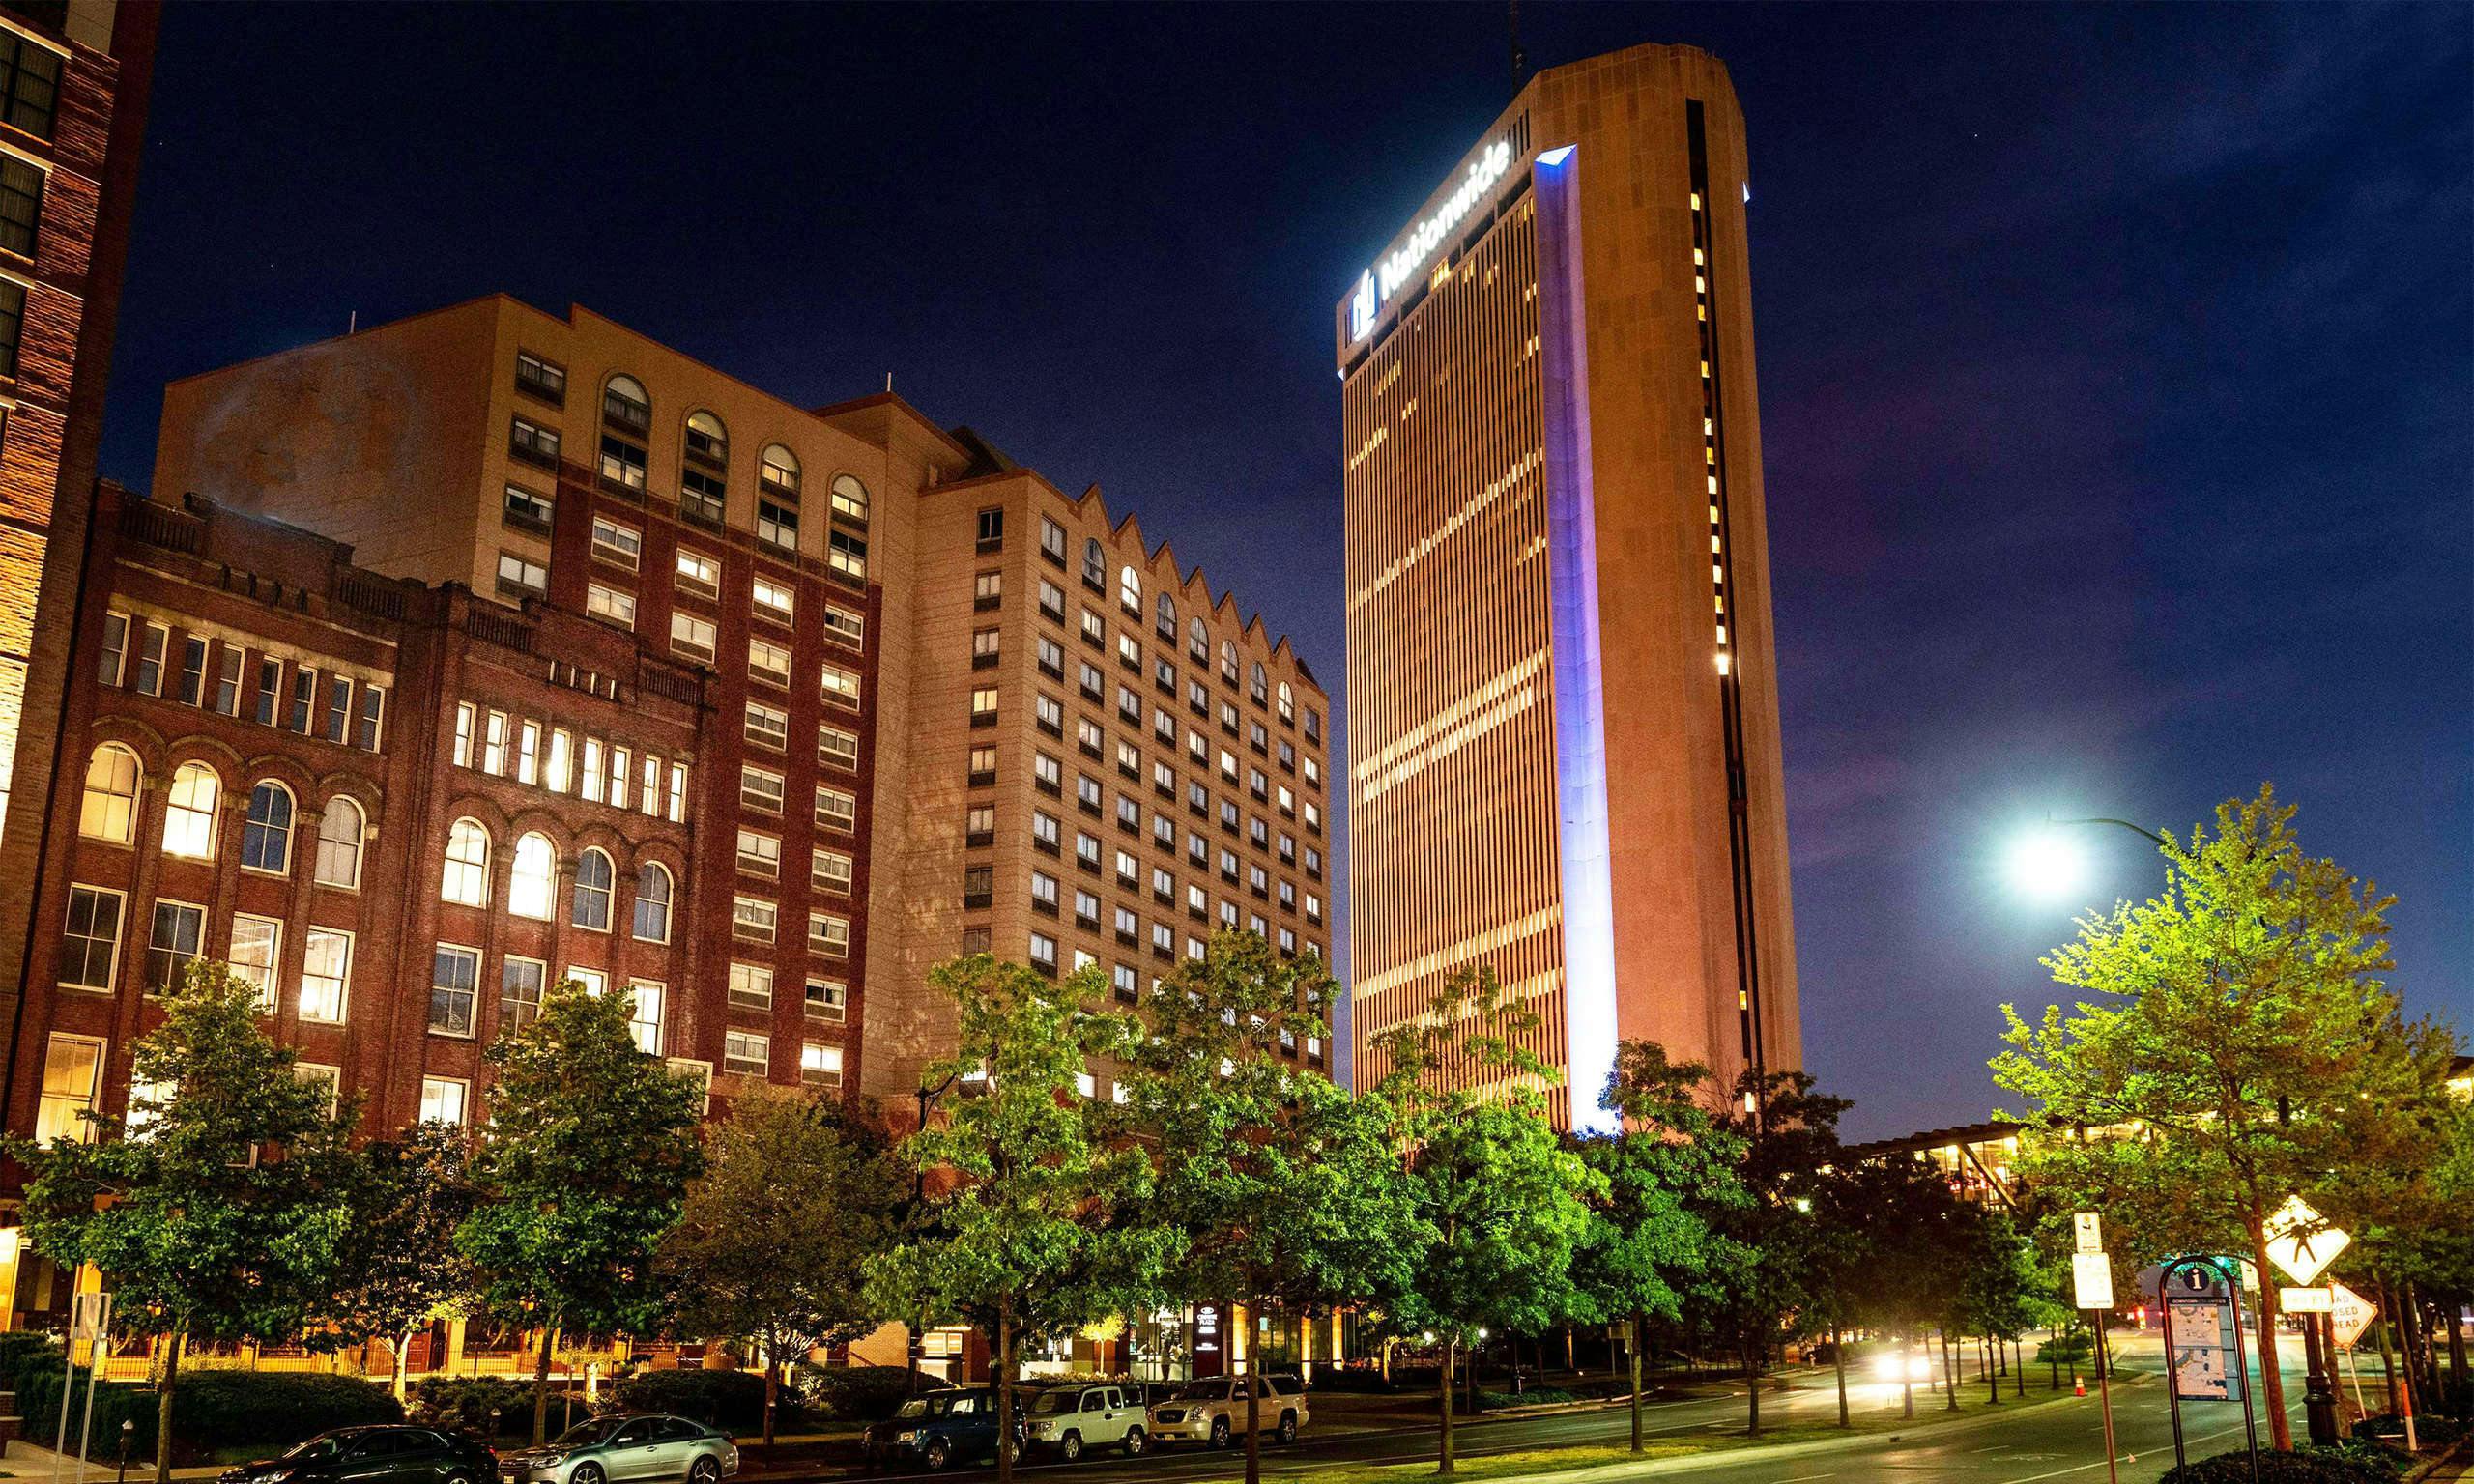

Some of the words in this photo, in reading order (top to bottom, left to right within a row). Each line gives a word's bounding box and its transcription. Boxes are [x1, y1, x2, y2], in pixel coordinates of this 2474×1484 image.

[1380, 141, 1510, 300] Nationwide
[2332, 1305, 2358, 1317] OSED
[2332, 1319, 2359, 1329] HEAD
